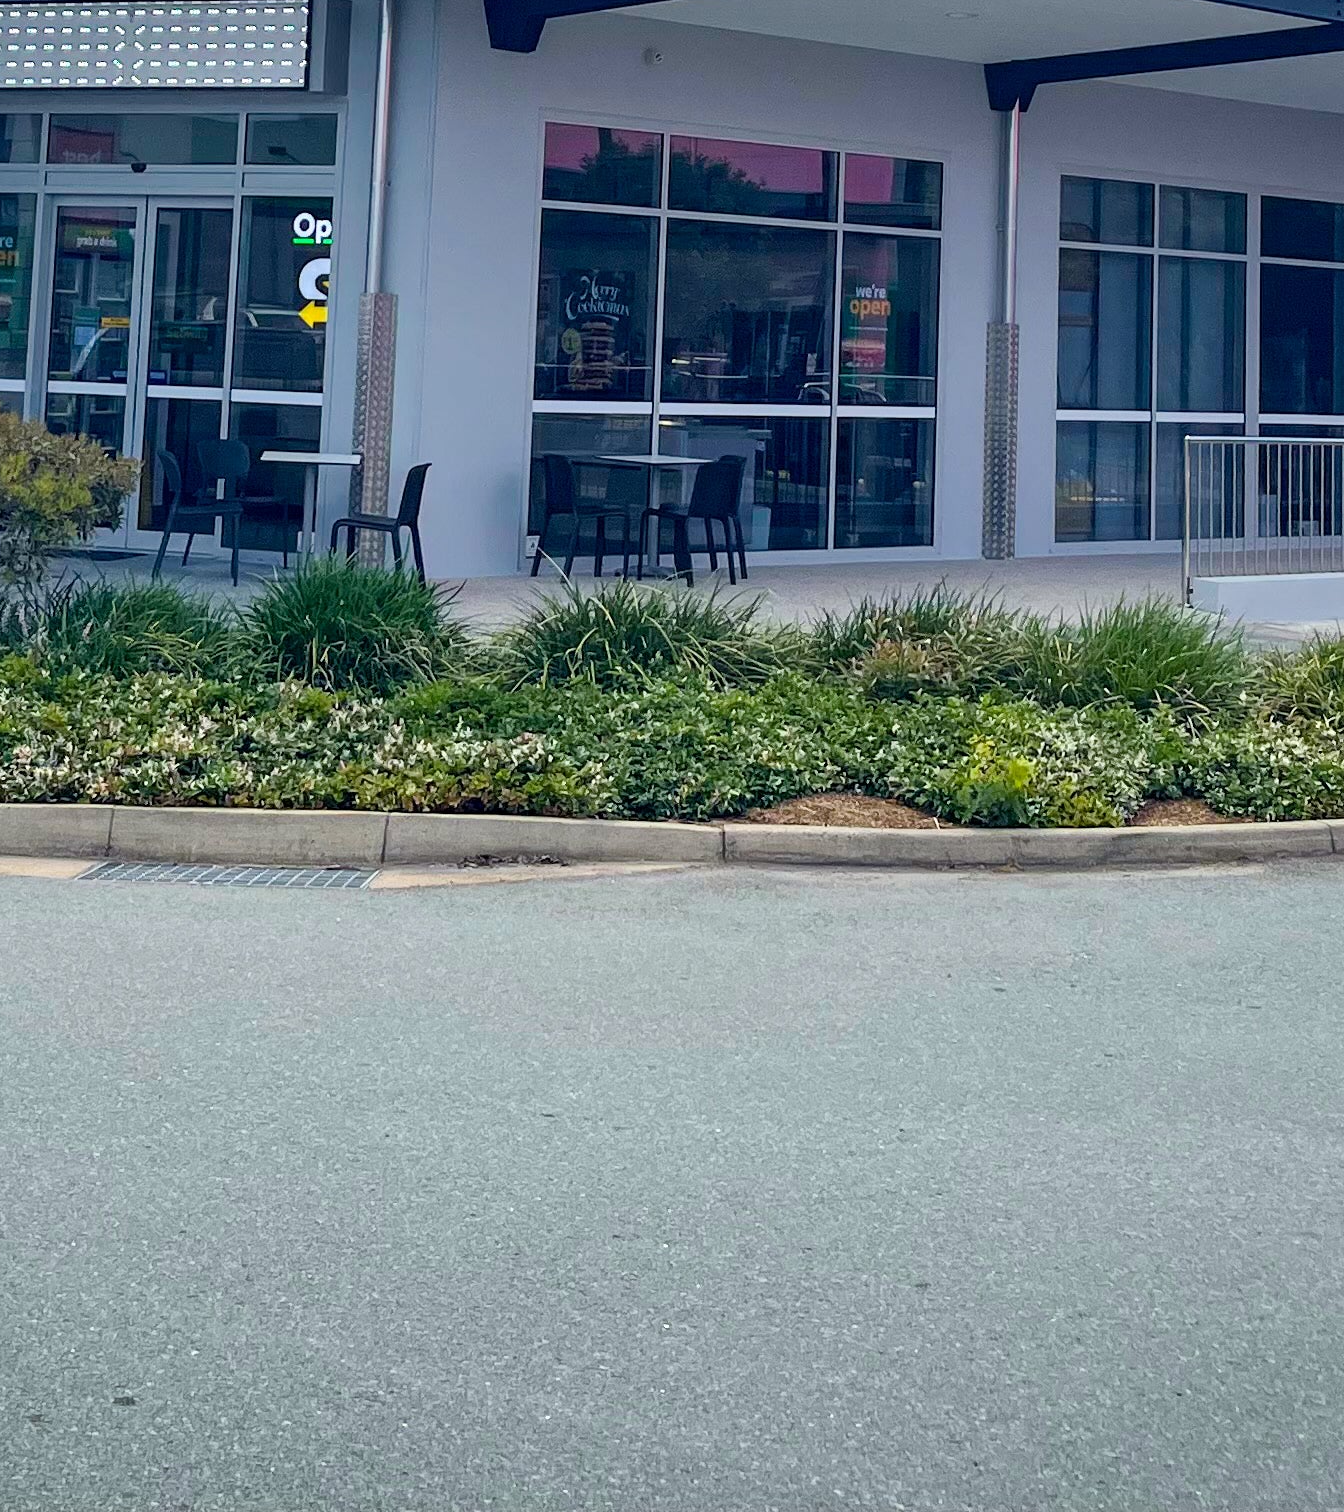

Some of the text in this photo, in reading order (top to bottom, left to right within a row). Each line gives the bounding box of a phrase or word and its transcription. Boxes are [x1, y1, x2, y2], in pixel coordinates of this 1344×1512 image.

[293, 212, 332, 244] Op
[856, 283, 887, 299] we're
[850, 299, 891, 321] open
